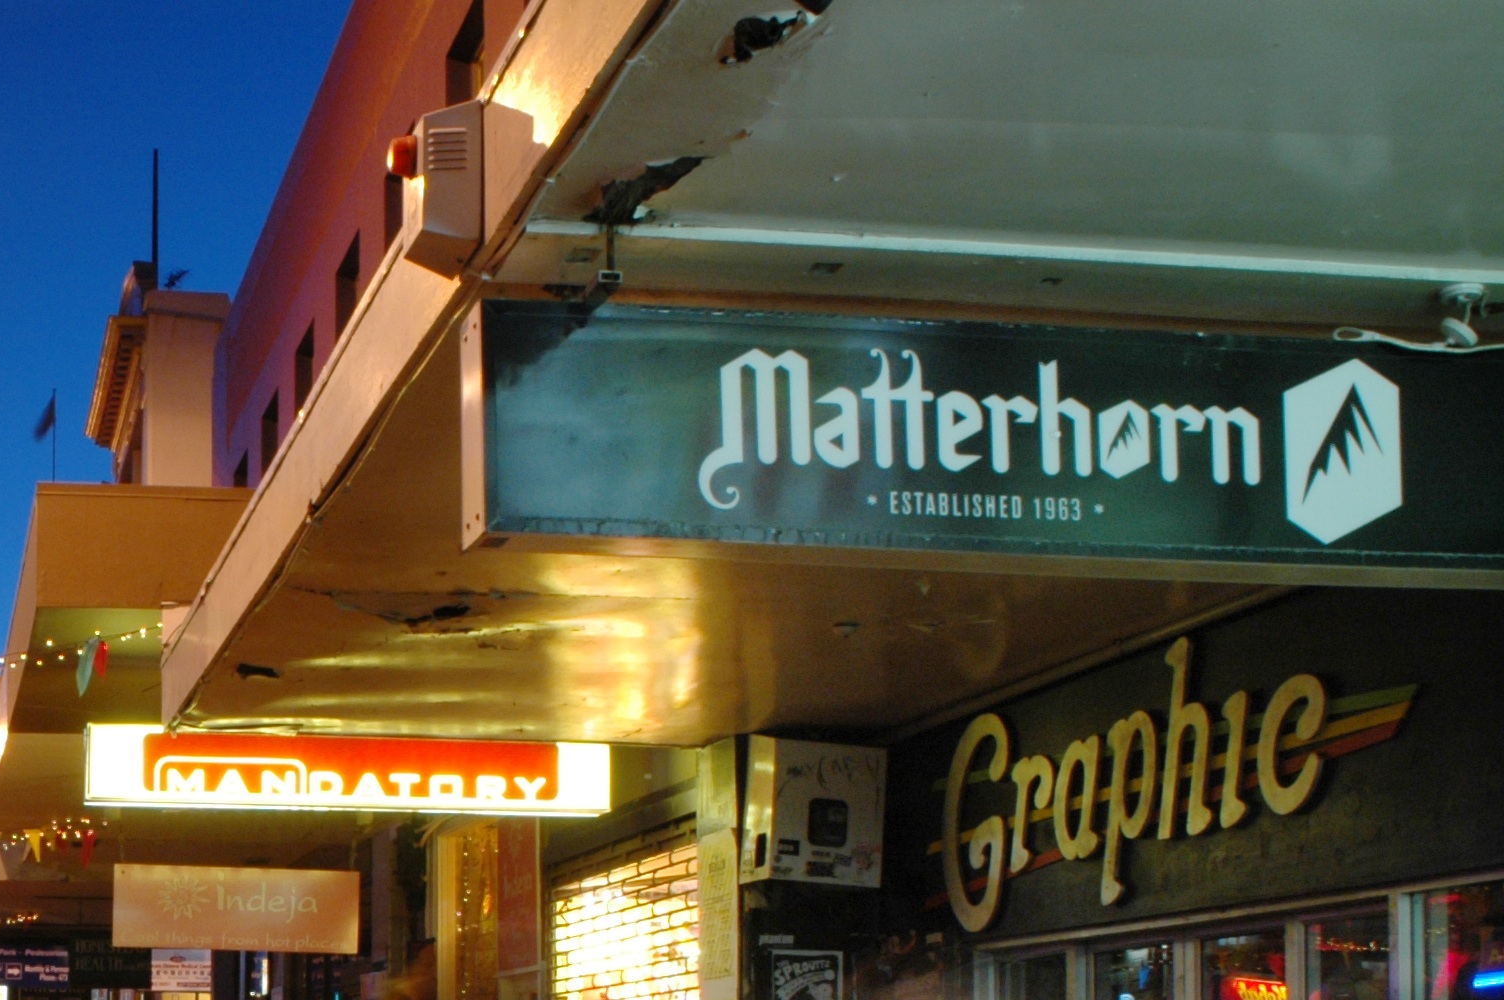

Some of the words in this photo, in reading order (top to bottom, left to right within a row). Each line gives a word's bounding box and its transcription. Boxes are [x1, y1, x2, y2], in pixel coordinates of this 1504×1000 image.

[698, 348, 1261, 511] Matterhorn
[889, 491, 1023, 519] ESTABLISHED
[1033, 496, 1083, 522] 1963
[164, 767, 548, 801] MANDATORY
[943, 636, 1327, 933] Graphic
[165, 929, 213, 948] things
[221, 931, 259, 948] from
[265, 931, 290, 947] hot
